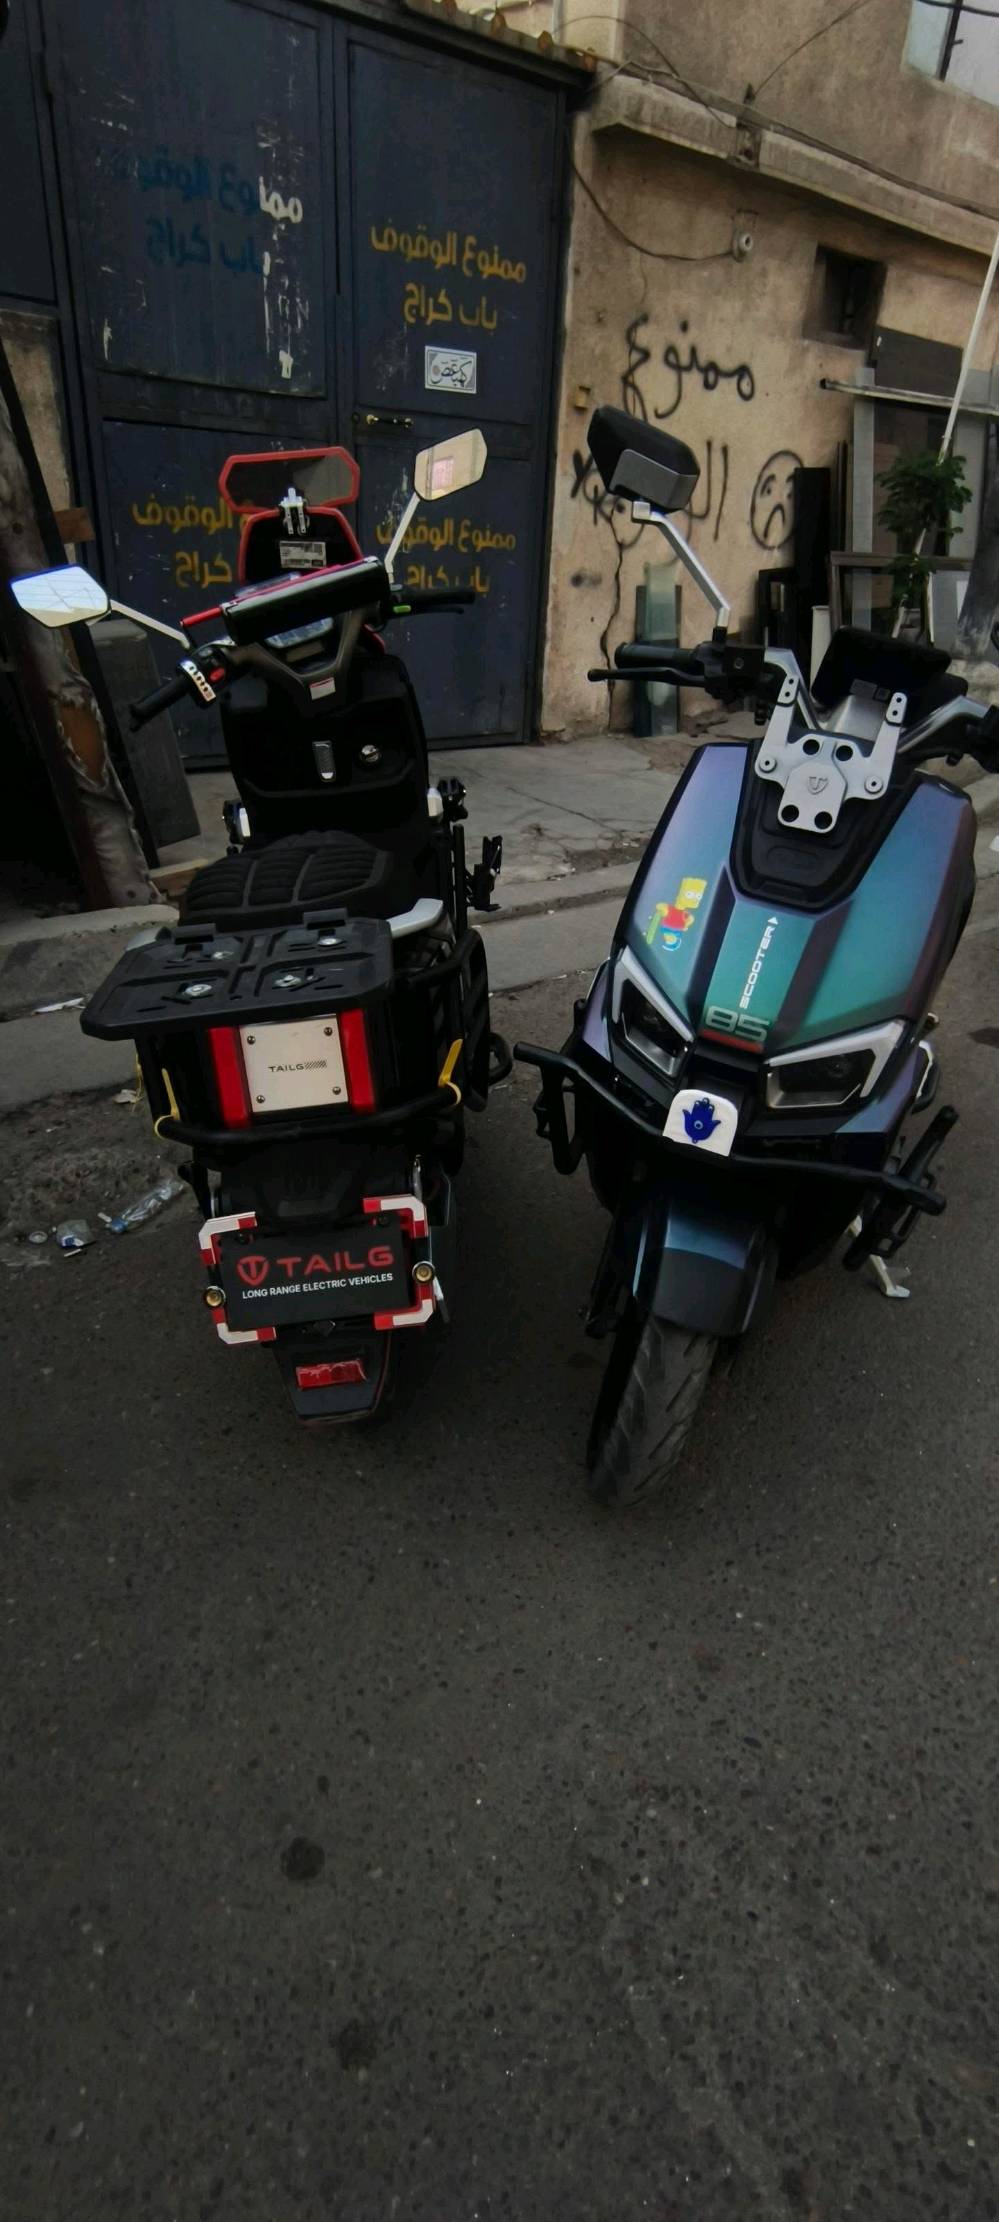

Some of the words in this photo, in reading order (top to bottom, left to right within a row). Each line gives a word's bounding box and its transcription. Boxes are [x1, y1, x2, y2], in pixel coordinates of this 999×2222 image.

[369, 217, 458, 270] الوقوف
[461, 234, 527, 284] ممنوع
[403, 281, 453, 325] كراج
[458, 296, 498, 336] باب
[621, 314, 755, 421] ممنوع
[131, 493, 234, 536] الوقوف
[457, 518, 517, 553] ممنوع
[175, 550, 233, 589] كراج
[739, 925, 776, 1009] SCOOTER
[268, 1063, 305, 1072] TAILG
[276, 1245, 395, 1278] TAILG
[242, 1287, 268, 1300] LONG
[269, 1283, 301, 1296] RANGE
[302, 1278, 347, 1292] ELECTRIC
[348, 1272, 394, 1287] VEHICLES
